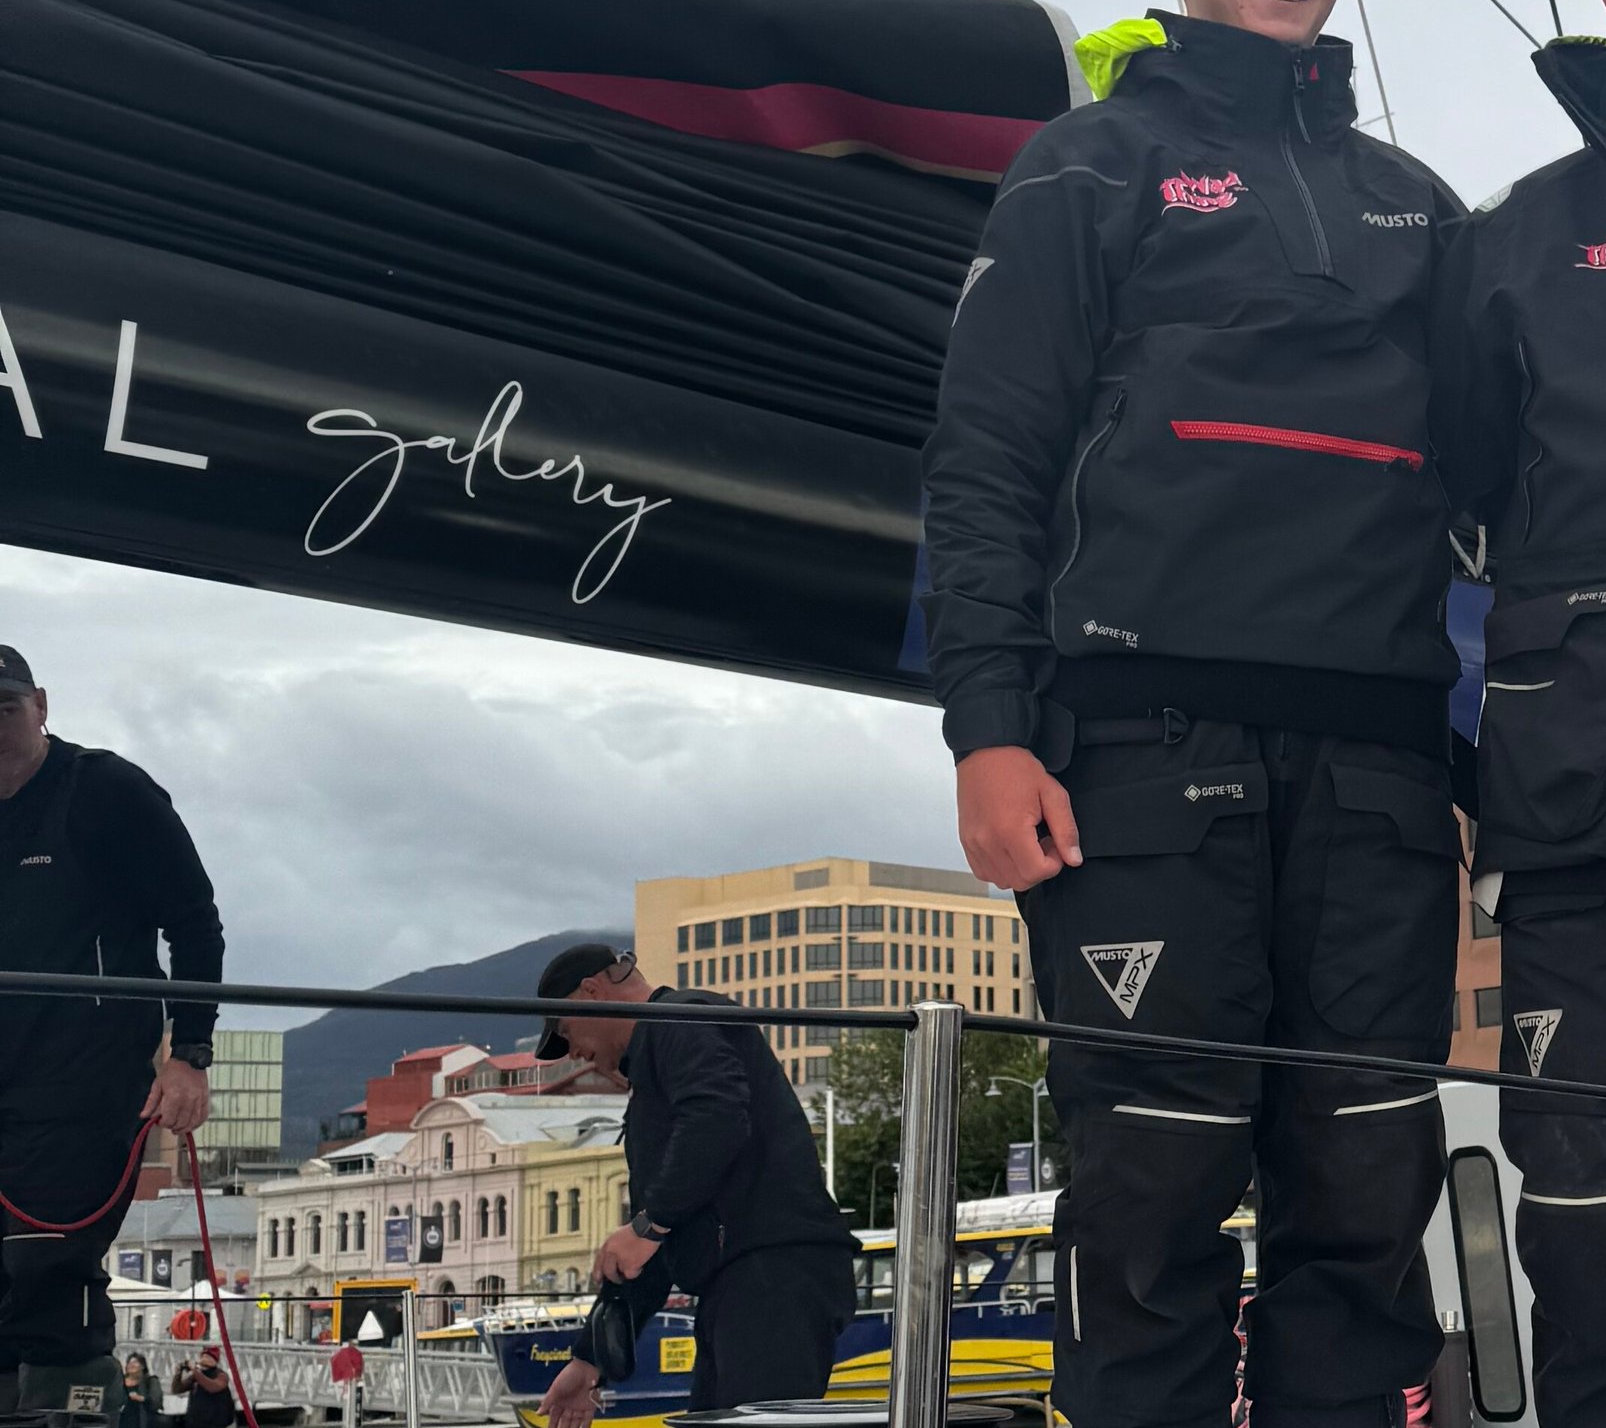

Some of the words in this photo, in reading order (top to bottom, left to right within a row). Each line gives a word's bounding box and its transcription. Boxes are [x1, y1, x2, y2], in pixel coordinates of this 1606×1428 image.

[1362, 212, 1429, 228] MUSTO
[1098, 625, 1139, 643] GORE-TEX
[1202, 783, 1243, 797] GORE-TEX
[1090, 949, 1131, 962] MUSTO
[1119, 947, 1154, 1004] MPX
